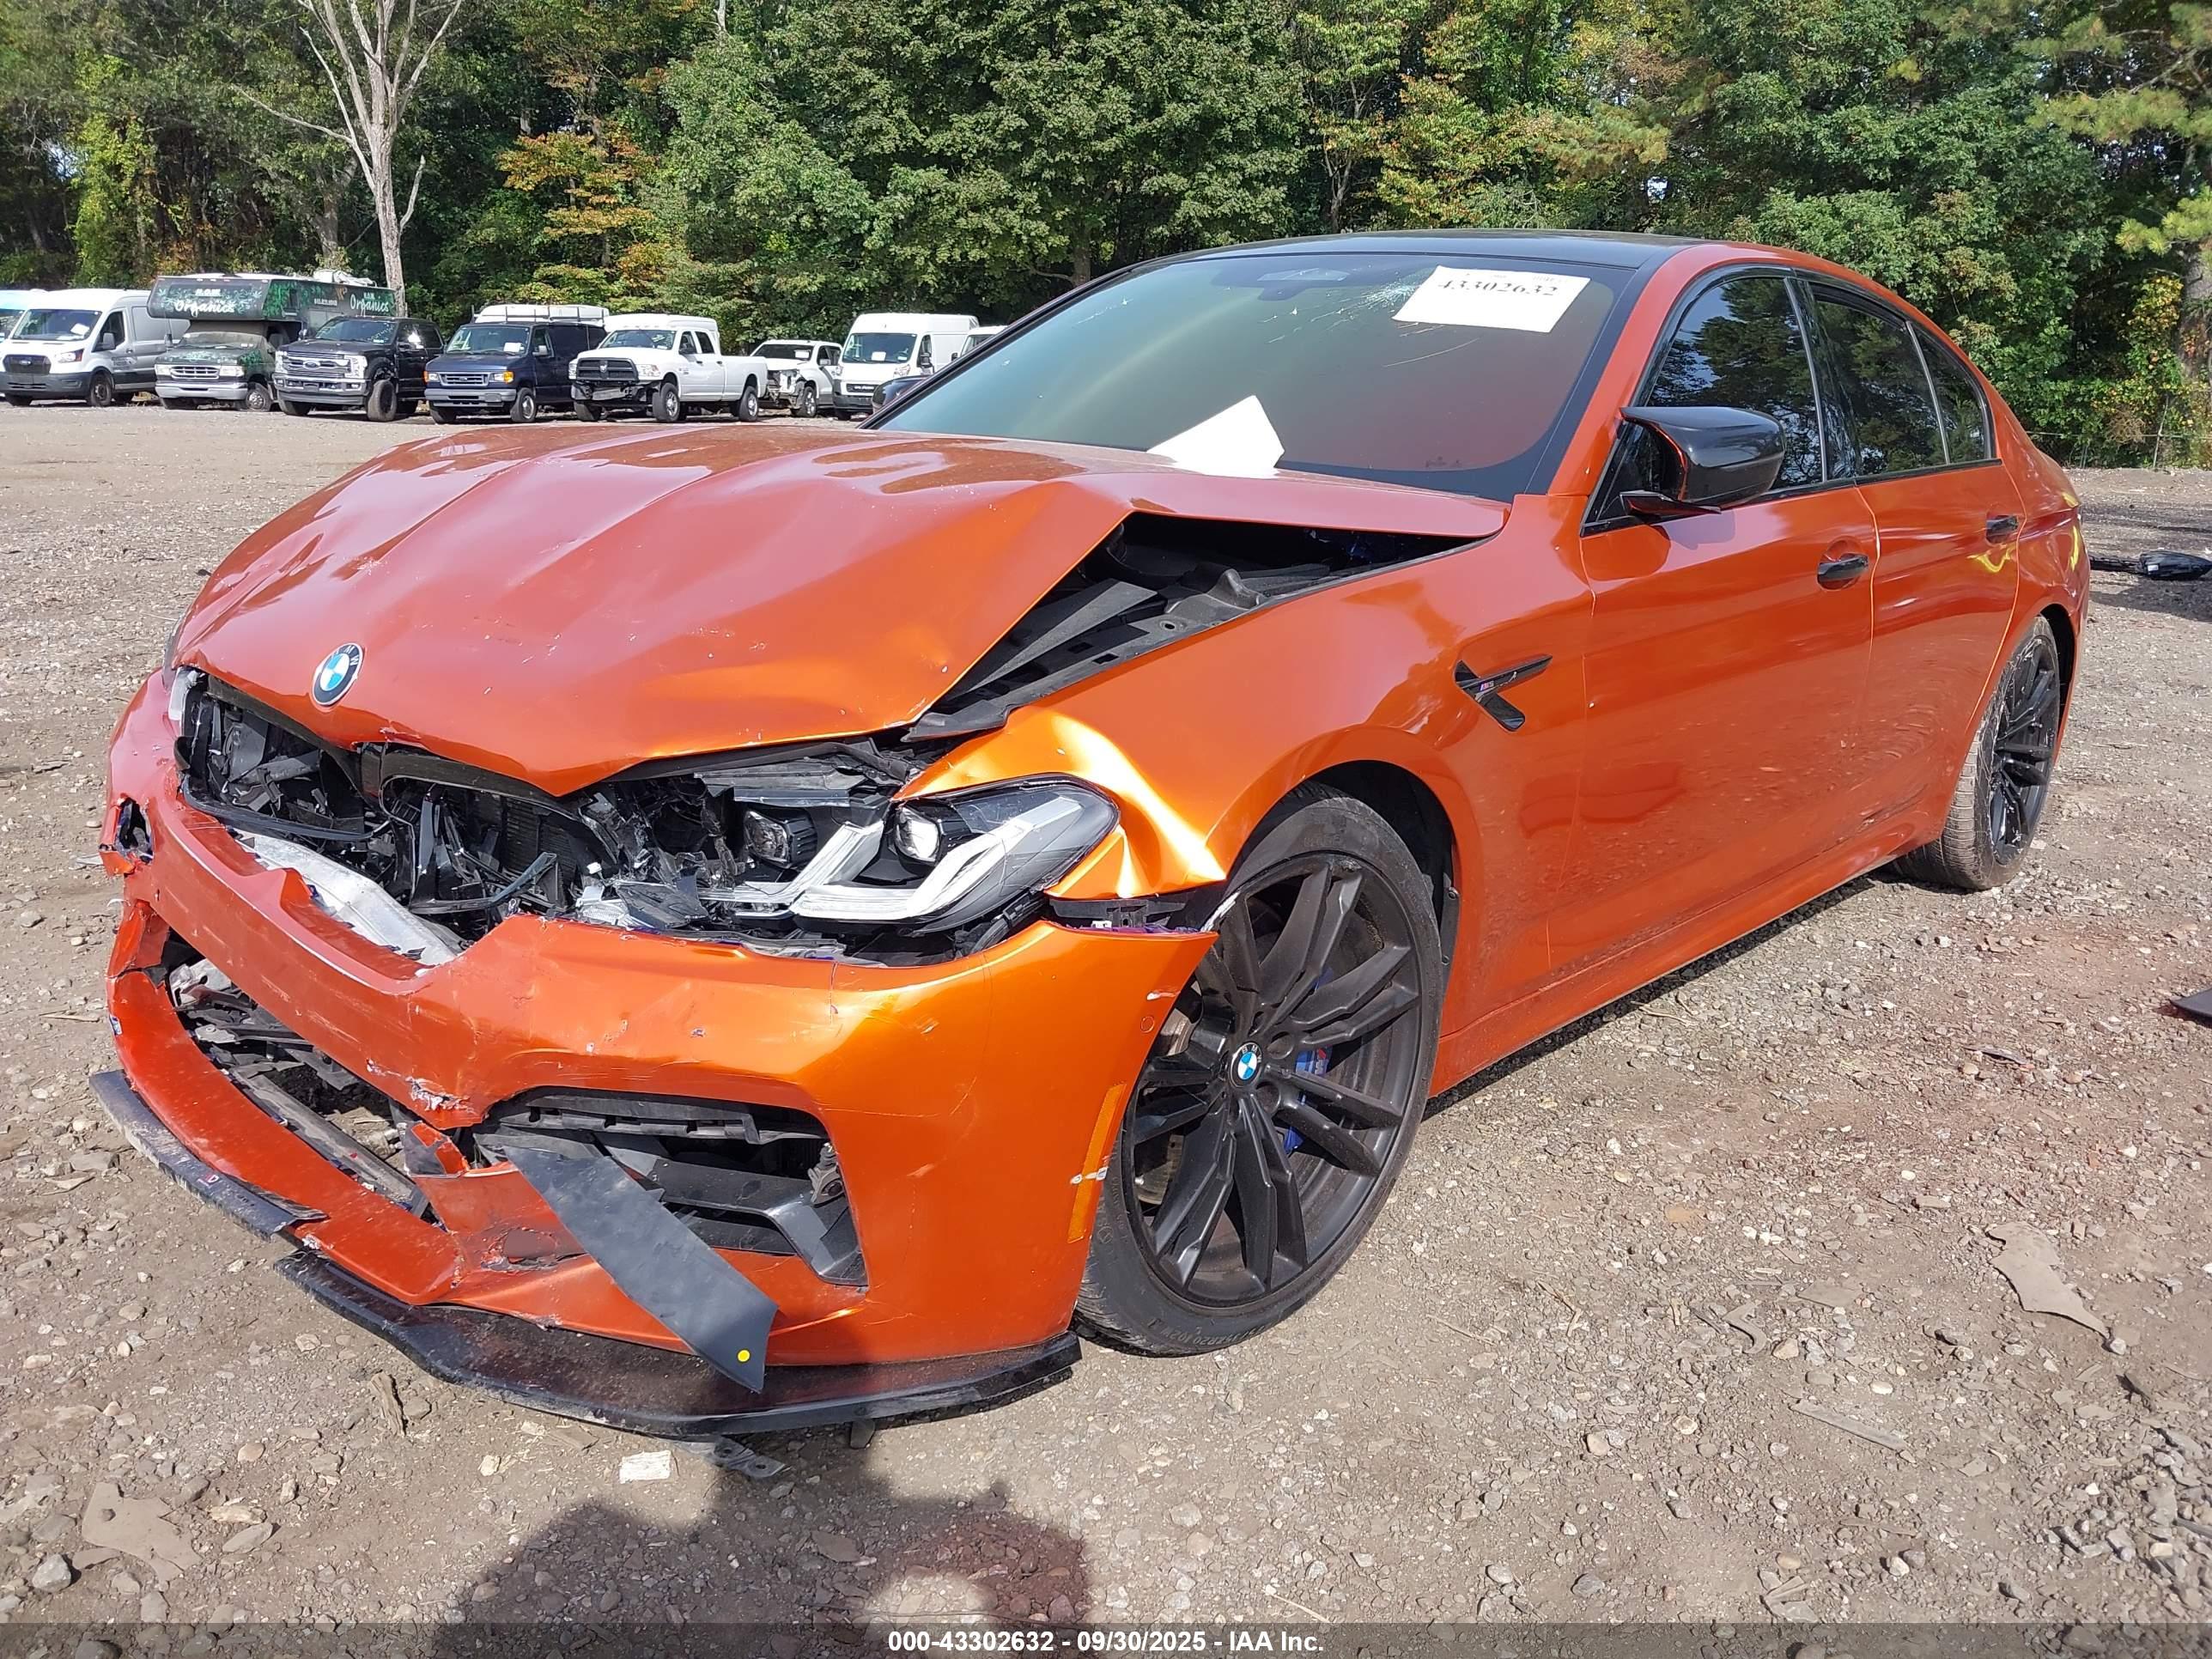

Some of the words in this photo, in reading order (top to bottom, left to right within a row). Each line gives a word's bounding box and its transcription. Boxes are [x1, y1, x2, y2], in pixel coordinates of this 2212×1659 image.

[1437, 279, 1559, 296] 43302632
[175, 299, 235, 318] Organics
[349, 293, 389, 316] Organics
